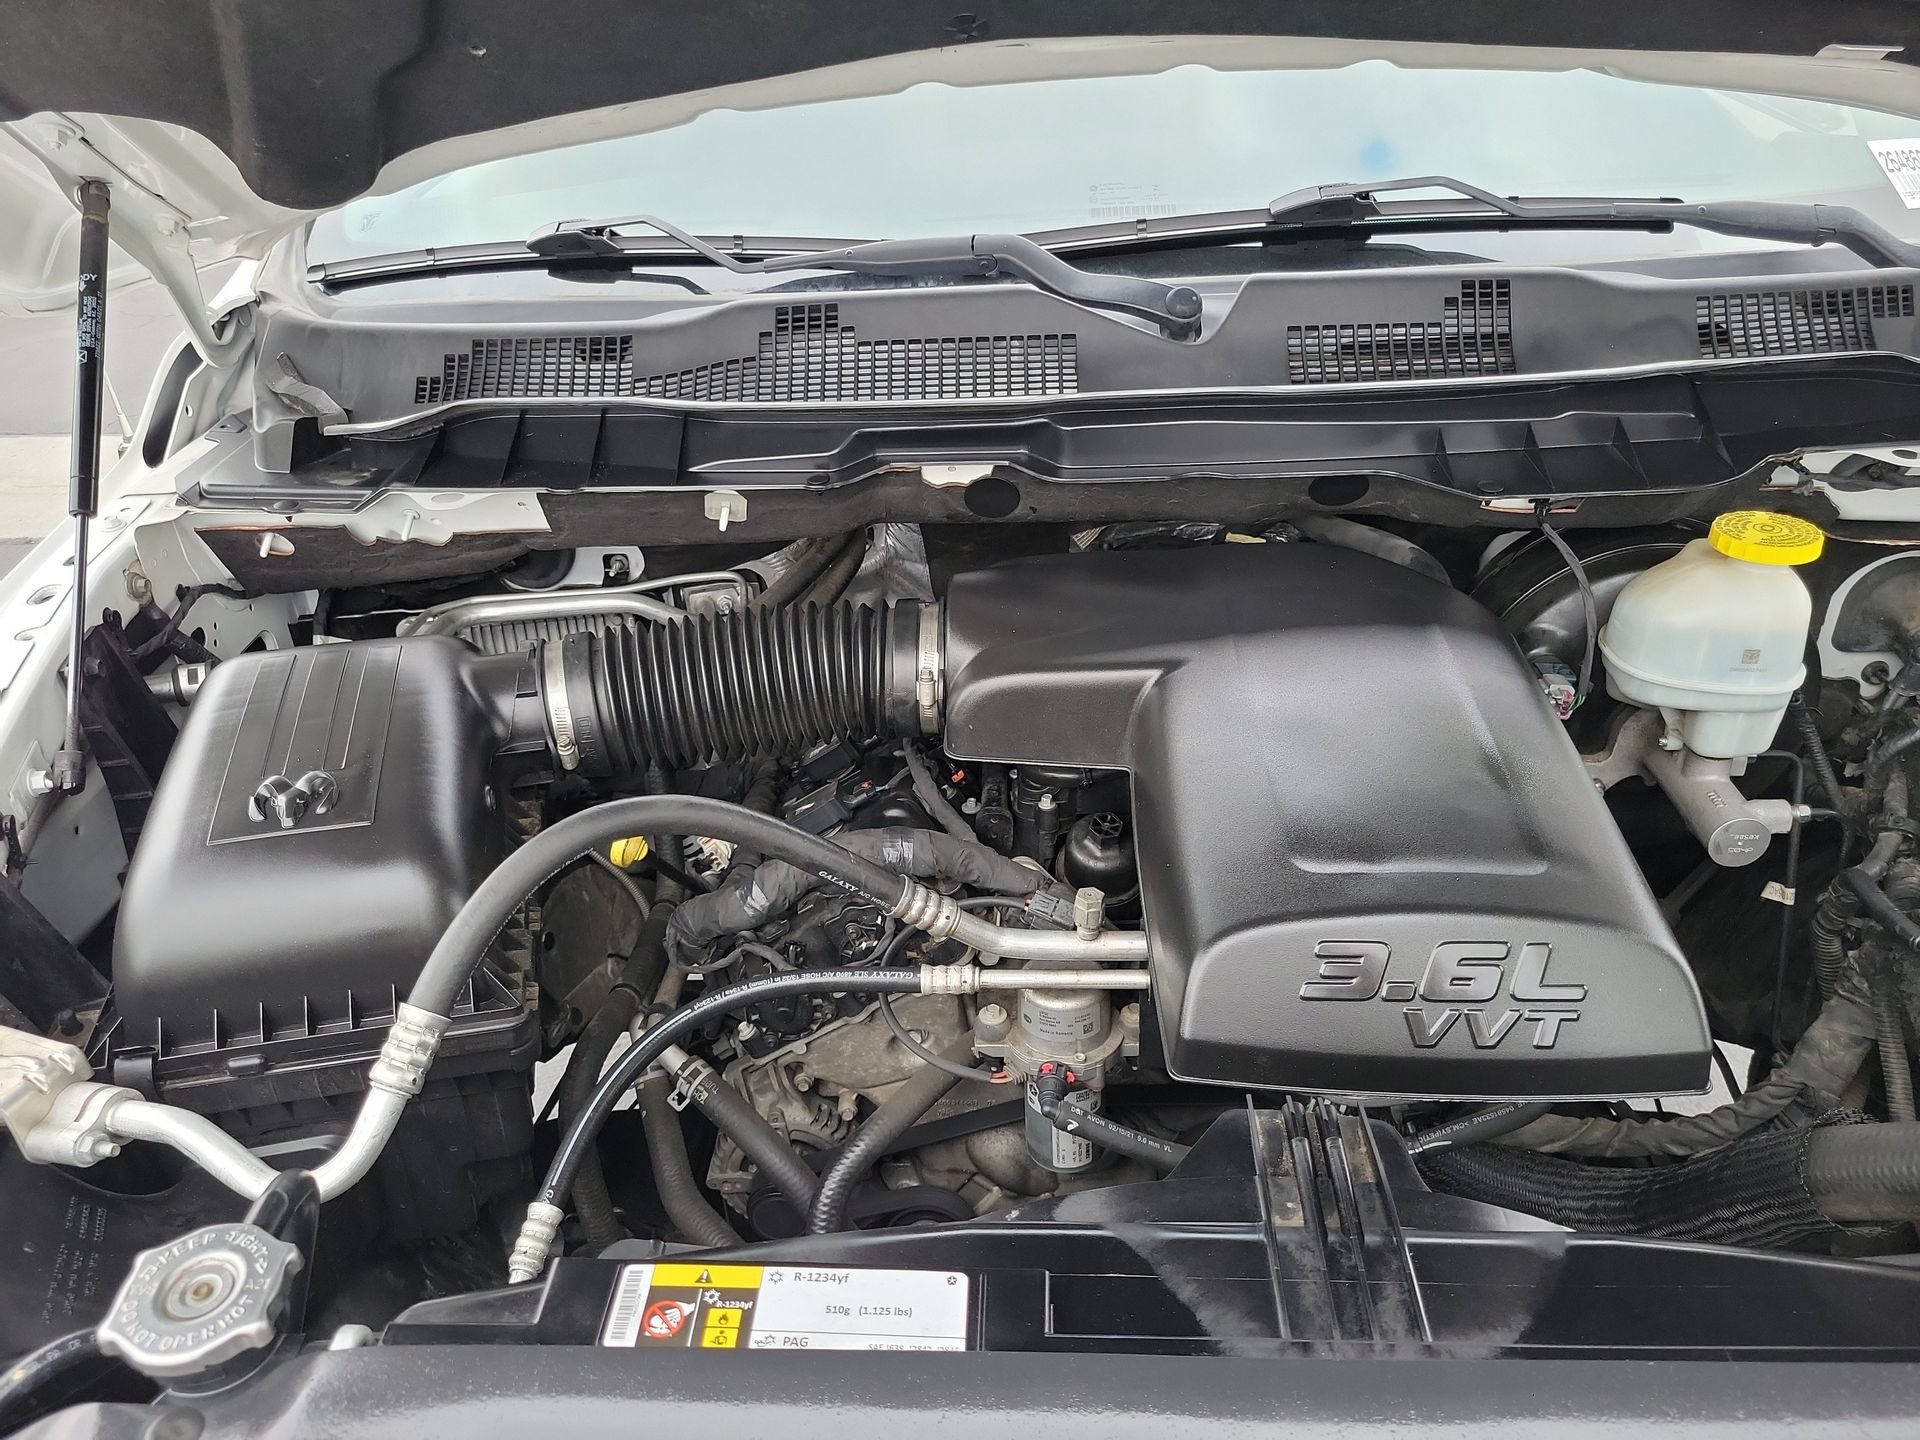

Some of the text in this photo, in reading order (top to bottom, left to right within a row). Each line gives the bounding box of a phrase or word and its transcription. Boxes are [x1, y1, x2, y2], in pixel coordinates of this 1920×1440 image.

[818, 870, 858, 892] GALAXY
[858, 889, 872, 901] A/C
[801, 972, 821, 980] HOSE
[854, 970, 869, 979] SLE
[870, 970, 915, 979] GALAXY
[1298, 938, 1589, 1003] 3.6L
[725, 984, 748, 995] R-134a
[749, 977, 774, 988] (10mm)
[693, 993, 721, 1011] R-1234yf
[1402, 1007, 1581, 1049] VVT
[1086, 1114, 1105, 1127] AVON
[1108, 1123, 1134, 1139] 02/15/21
[1148, 1139, 1160, 1149] mm
[158, 1231, 217, 1265] KEEP
[793, 1271, 851, 1286] R-1234yf
[716, 1300, 754, 1310] R-1234yf
[824, 1305, 914, 1319] 510g (1.125 lbs)
[119, 1293, 255, 1352] DO NOT OPEN HOT
[782, 1335, 810, 1348] PAG
